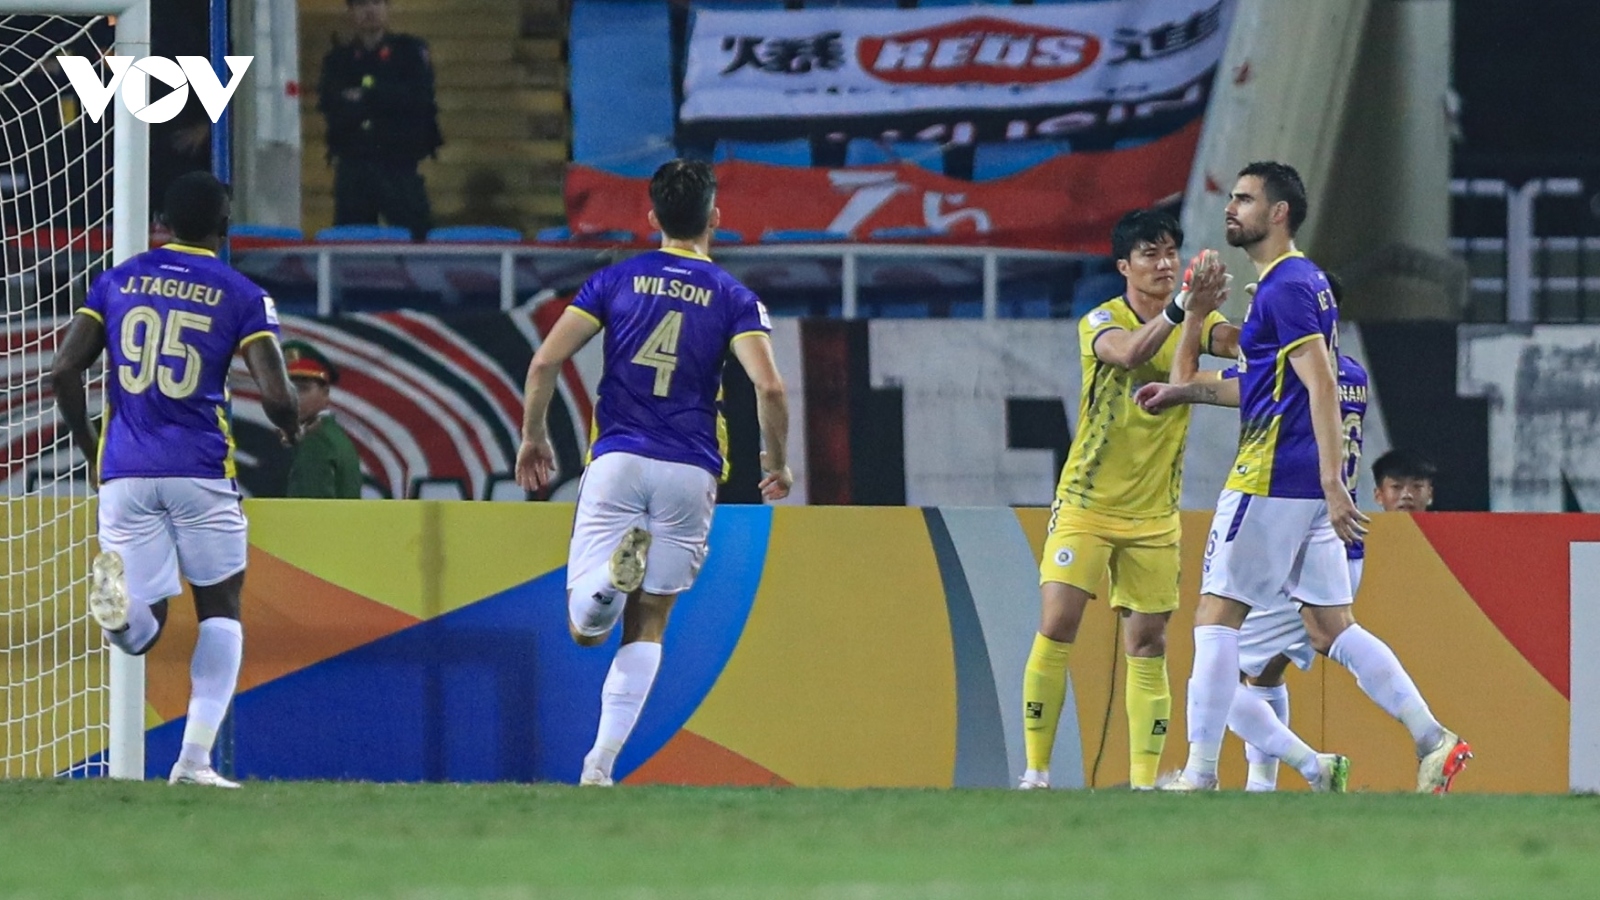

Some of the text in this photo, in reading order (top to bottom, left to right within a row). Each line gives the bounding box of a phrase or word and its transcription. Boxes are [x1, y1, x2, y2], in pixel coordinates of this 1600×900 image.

[872, 33, 1087, 71] REDS
[120, 276, 223, 306] J.TAGUEU
[633, 277, 712, 306] WILSON
[118, 305, 213, 399] 95
[631, 310, 684, 398] 4
